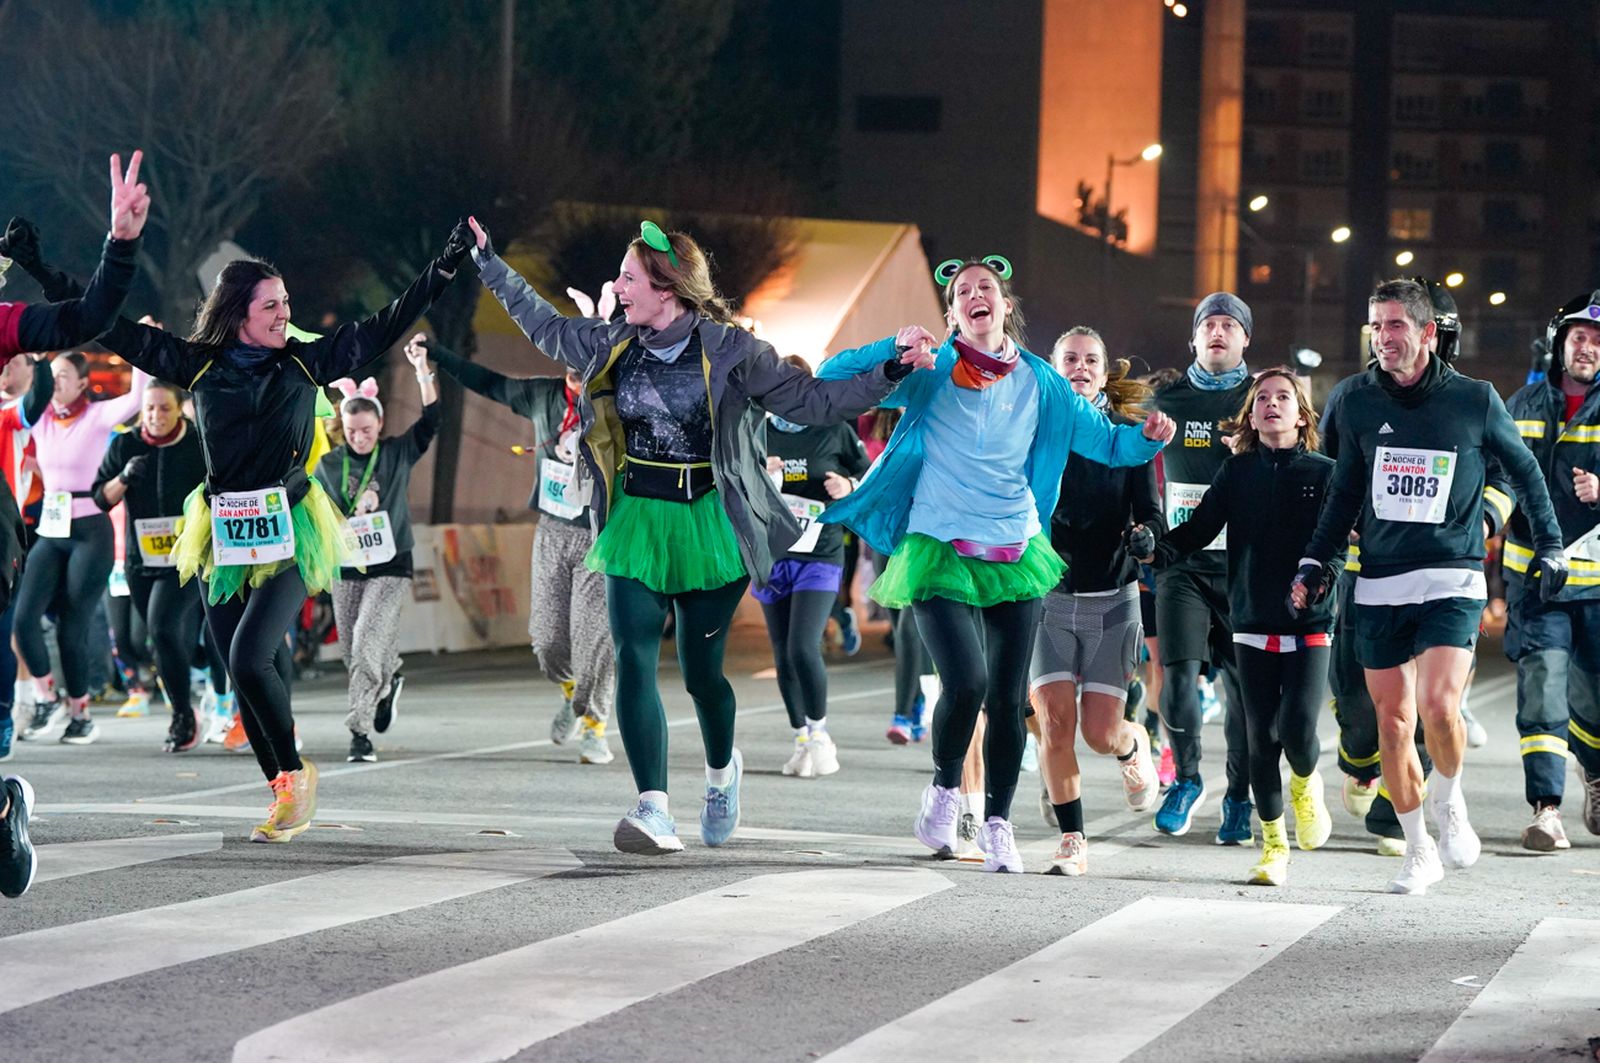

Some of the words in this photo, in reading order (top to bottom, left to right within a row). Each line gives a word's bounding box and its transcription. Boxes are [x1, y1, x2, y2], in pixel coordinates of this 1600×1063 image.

[1184, 438, 1210, 447] BOX
[1382, 464, 1399, 472] SAN
[784, 473, 807, 482] BOX
[1387, 474, 1439, 498] 3083
[226, 500, 247, 508] NOCHE
[249, 499, 258, 507] DE
[218, 509, 232, 517] SAN
[224, 515, 280, 540] 12781
